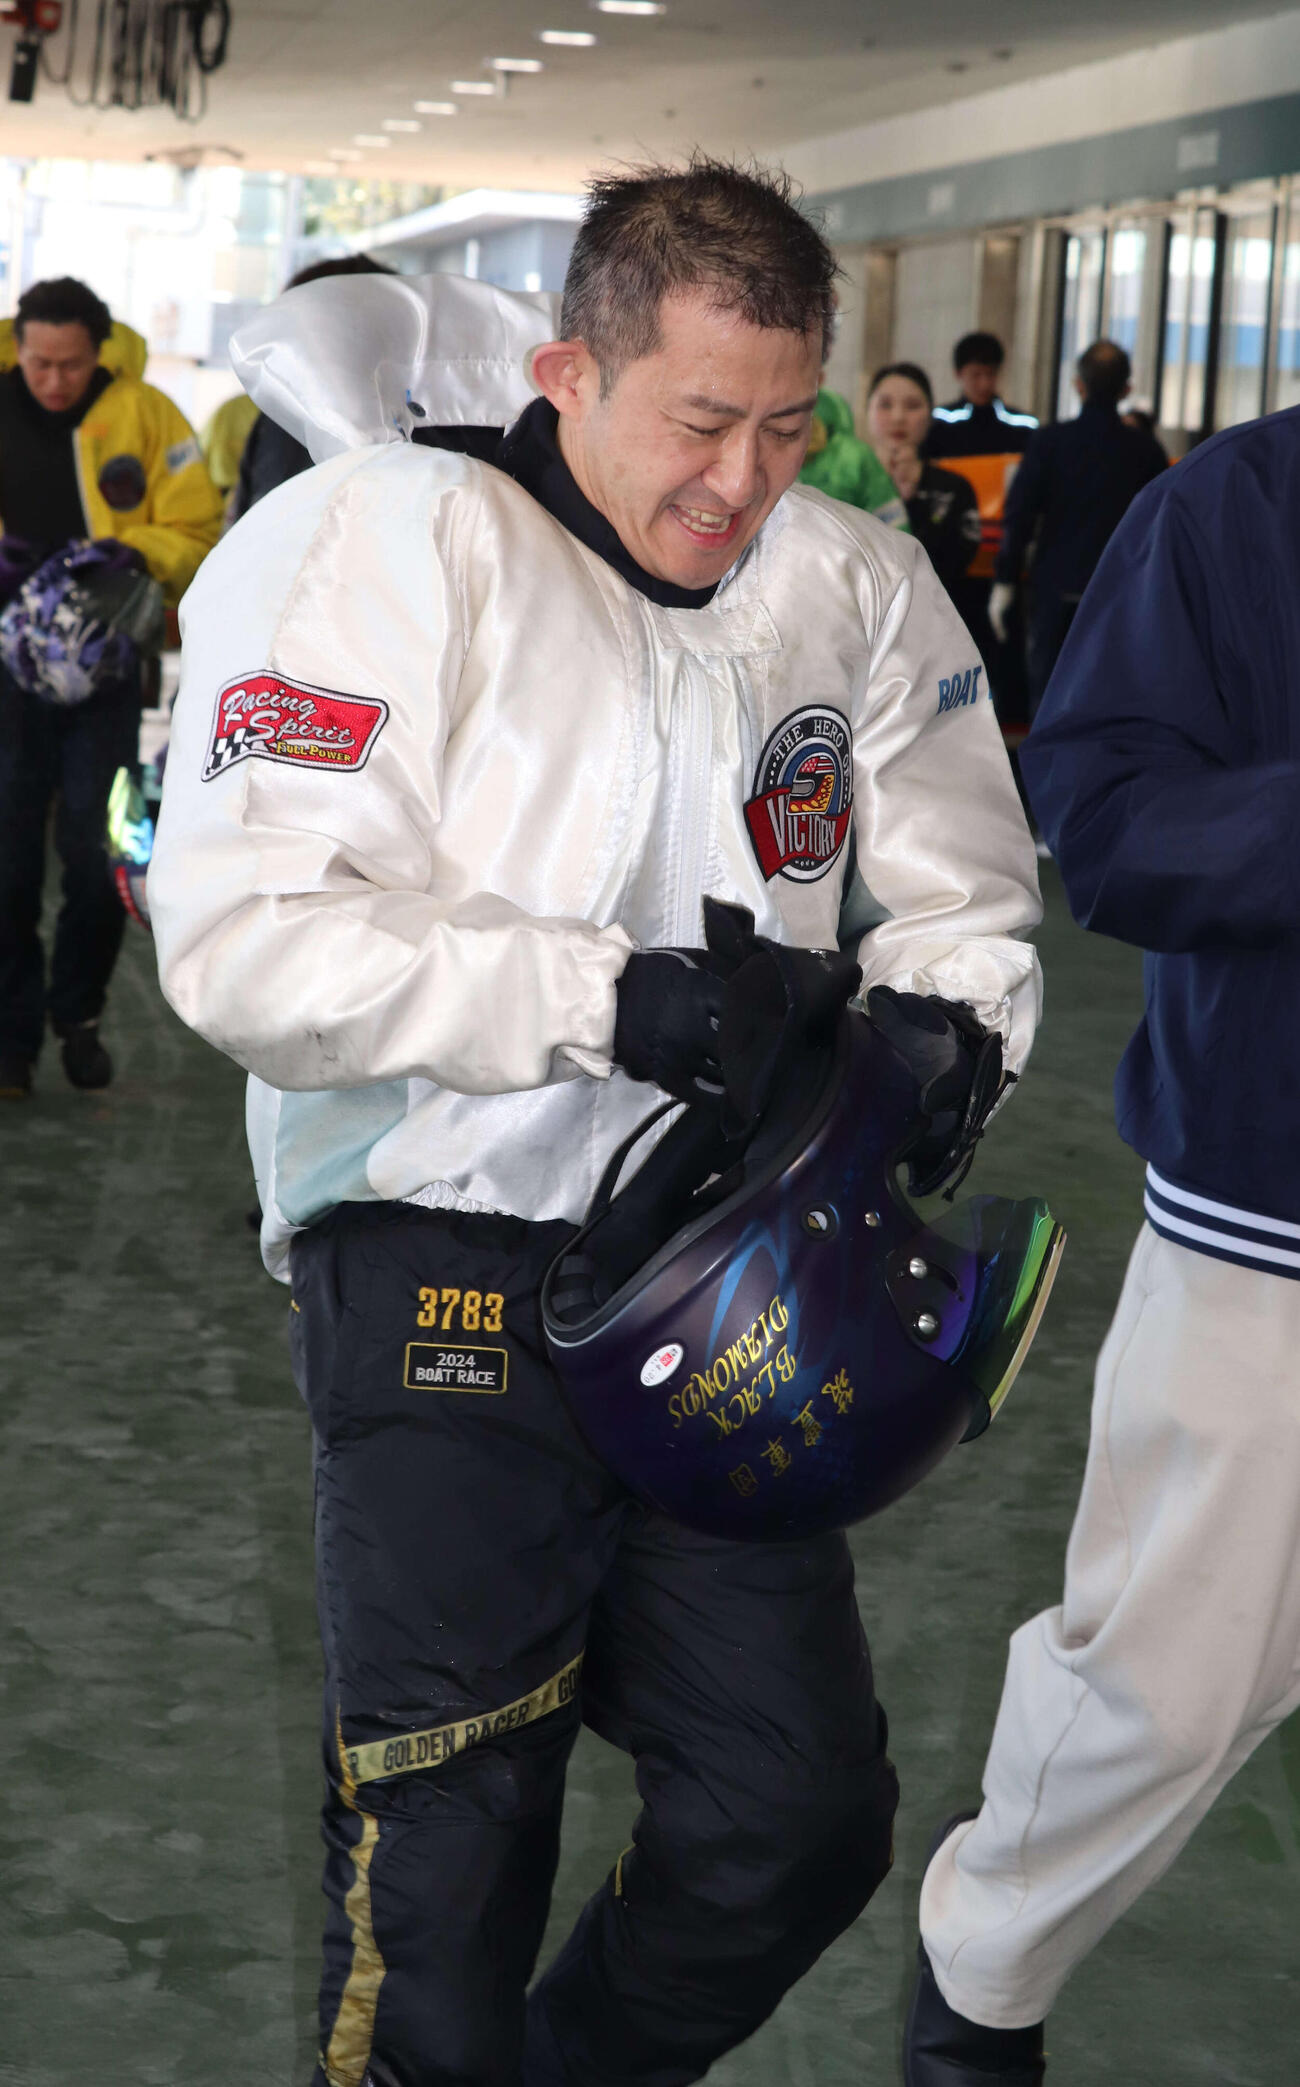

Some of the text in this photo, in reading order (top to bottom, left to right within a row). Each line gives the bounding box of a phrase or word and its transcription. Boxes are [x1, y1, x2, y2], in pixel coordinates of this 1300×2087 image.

[222, 689, 317, 732] Racing
[937, 665, 982, 716] BOAT
[244, 710, 356, 744] Spirit
[774, 725, 804, 760] THE
[814, 719, 844, 747] HERO
[309, 744, 351, 762] POWER
[766, 794, 836, 858] VICTORY
[417, 1286, 504, 1332] 3783
[415, 1367, 496, 1385] BOAT RACE
[436, 1353, 476, 1368] 2024
[668, 1295, 789, 1428] DIAMONDS
[706, 1344, 796, 1440] BLACK
[384, 1729, 456, 1772] GOLDEN
[465, 1702, 530, 1747] RACER
